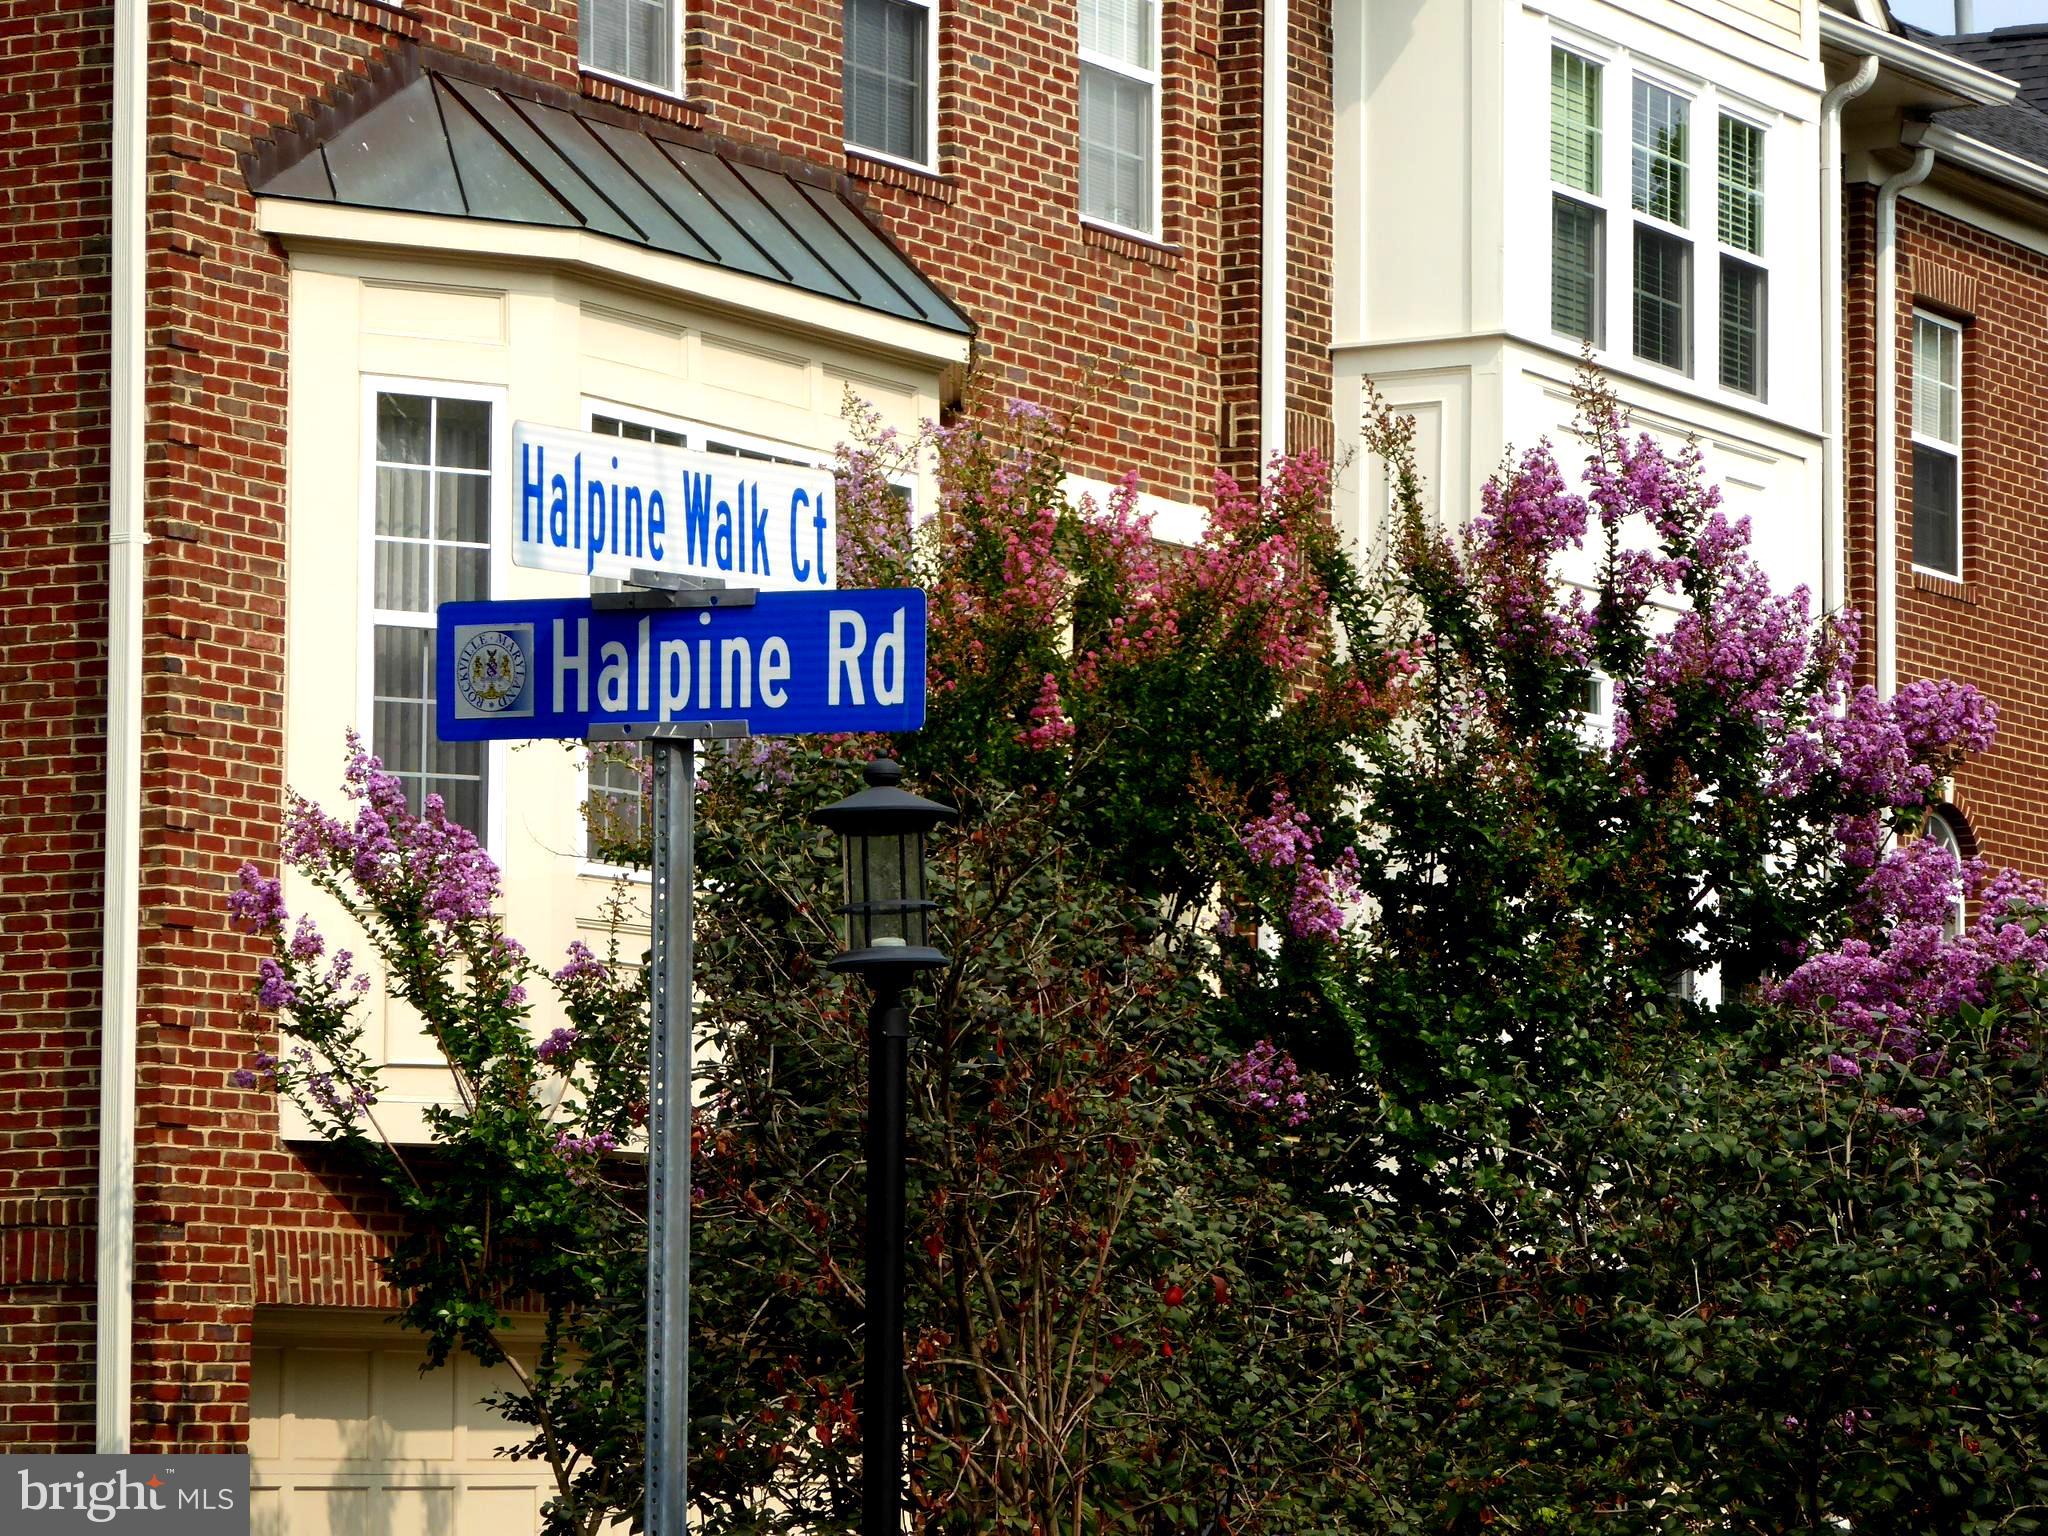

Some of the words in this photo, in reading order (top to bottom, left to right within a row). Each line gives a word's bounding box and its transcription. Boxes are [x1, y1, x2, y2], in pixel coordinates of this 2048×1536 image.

[521, 442, 665, 576] Halpine
[683, 469, 771, 577] Walk
[789, 487, 827, 586] Ct
[459, 634, 487, 709] ROCKVILLE
[497, 633, 525, 708] MARYLAND
[552, 612, 791, 722] Halpine
[827, 606, 905, 707] Rd
